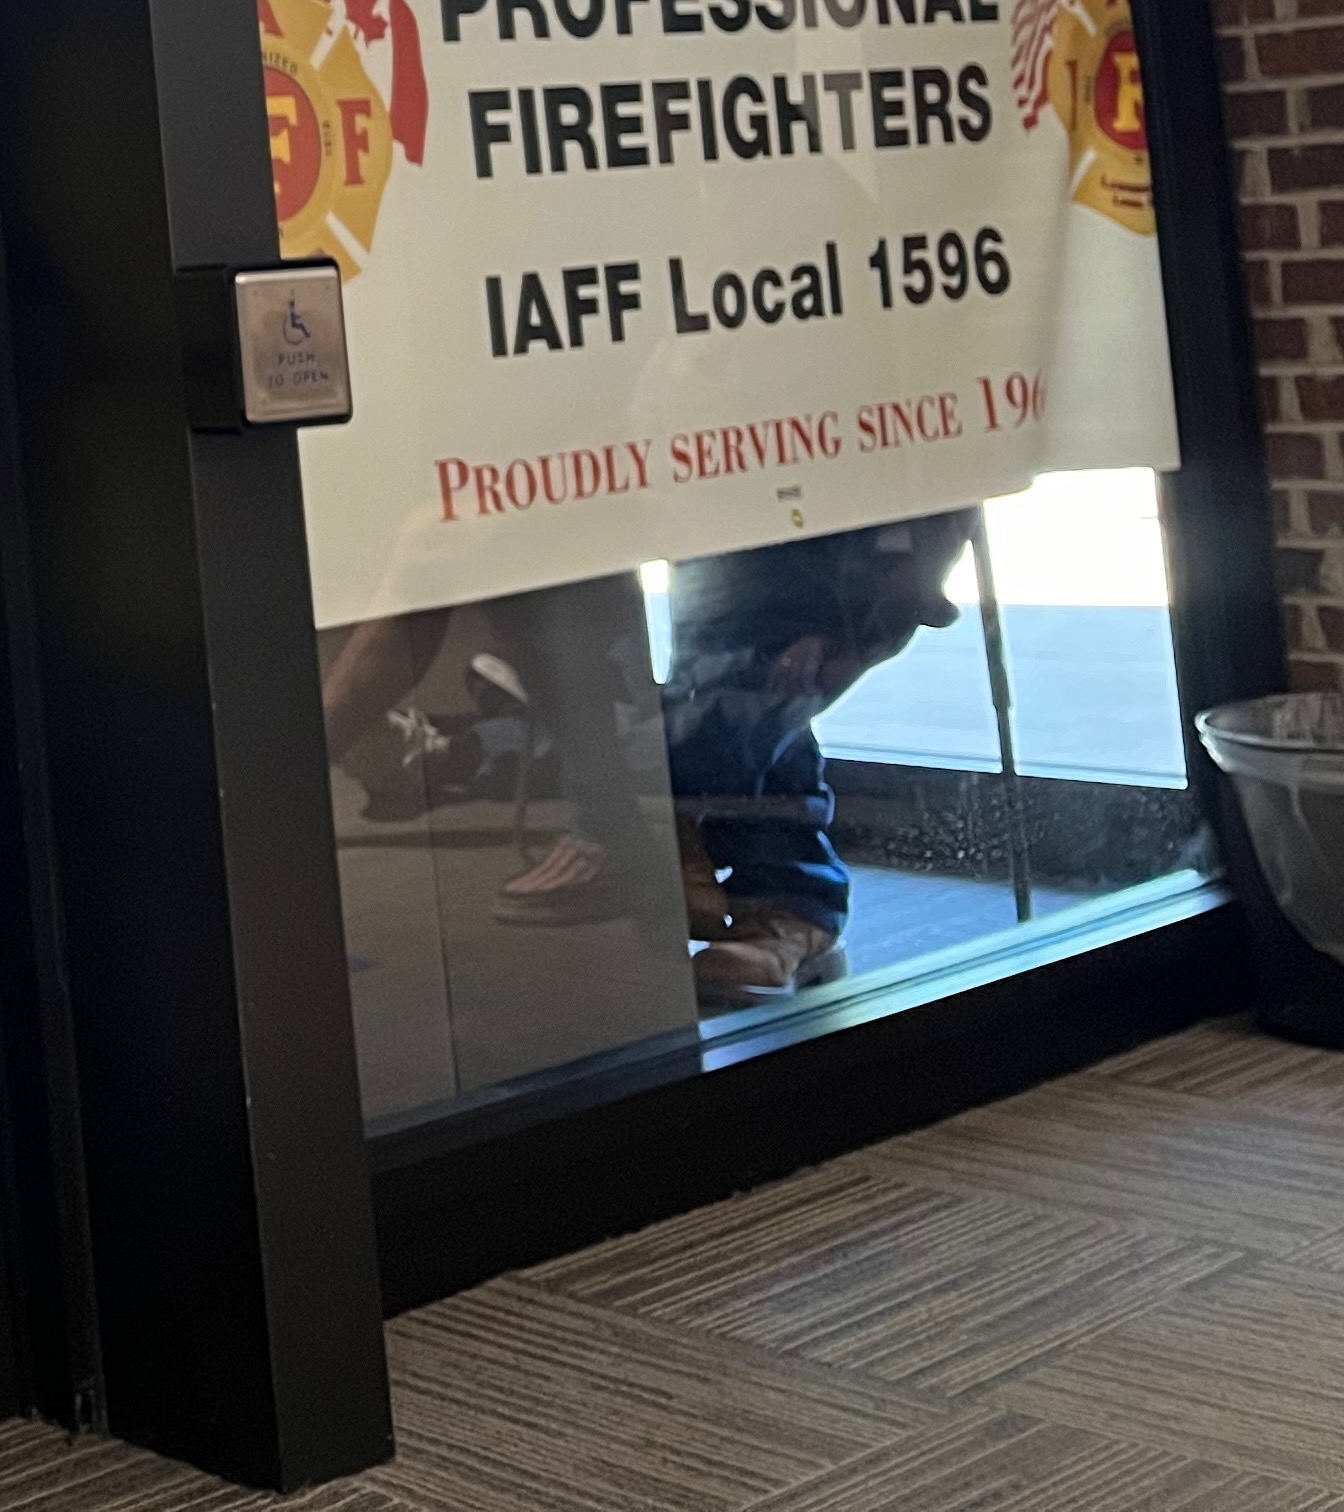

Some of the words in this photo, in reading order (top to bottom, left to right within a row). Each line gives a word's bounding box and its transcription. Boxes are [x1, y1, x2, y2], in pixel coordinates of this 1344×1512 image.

[467, 62, 994, 180] FIREFIGHTERS
[485, 260, 642, 358] IAFF
[668, 241, 843, 335] Local
[867, 226, 1012, 310] 1596
[268, 374, 284, 388] TO
[293, 371, 329, 386] OPEN
[278, 353, 316, 367] PUSH
[434, 439, 652, 523] PROUDLY
[670, 410, 842, 483] SERVING
[856, 392, 963, 454] SINCE
